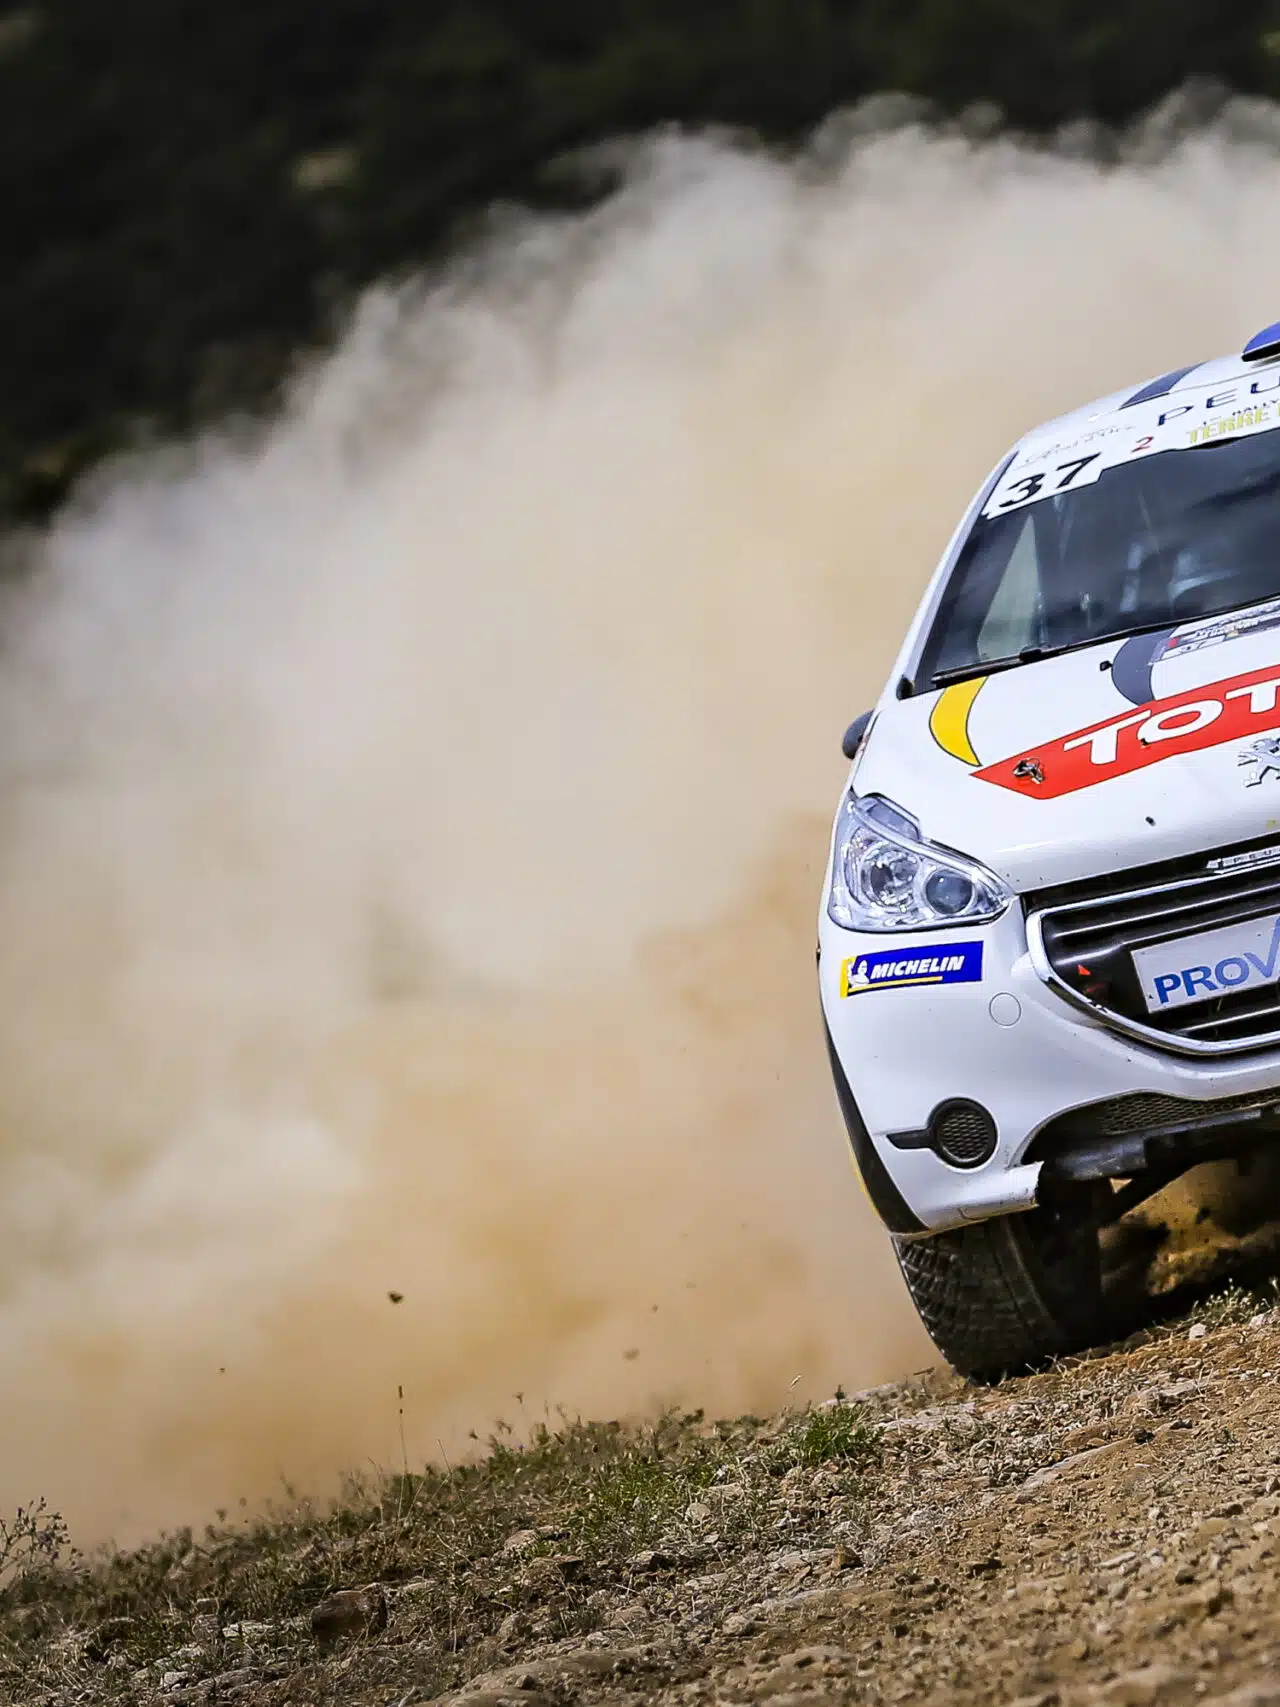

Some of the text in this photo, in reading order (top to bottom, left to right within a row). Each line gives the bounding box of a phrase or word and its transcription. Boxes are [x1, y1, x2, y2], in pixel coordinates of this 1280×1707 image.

[1186, 408, 1270, 444] TERRE
[1131, 436, 1155, 453] 2
[998, 451, 1102, 508] 37
[870, 955, 966, 980] MICHELIN
